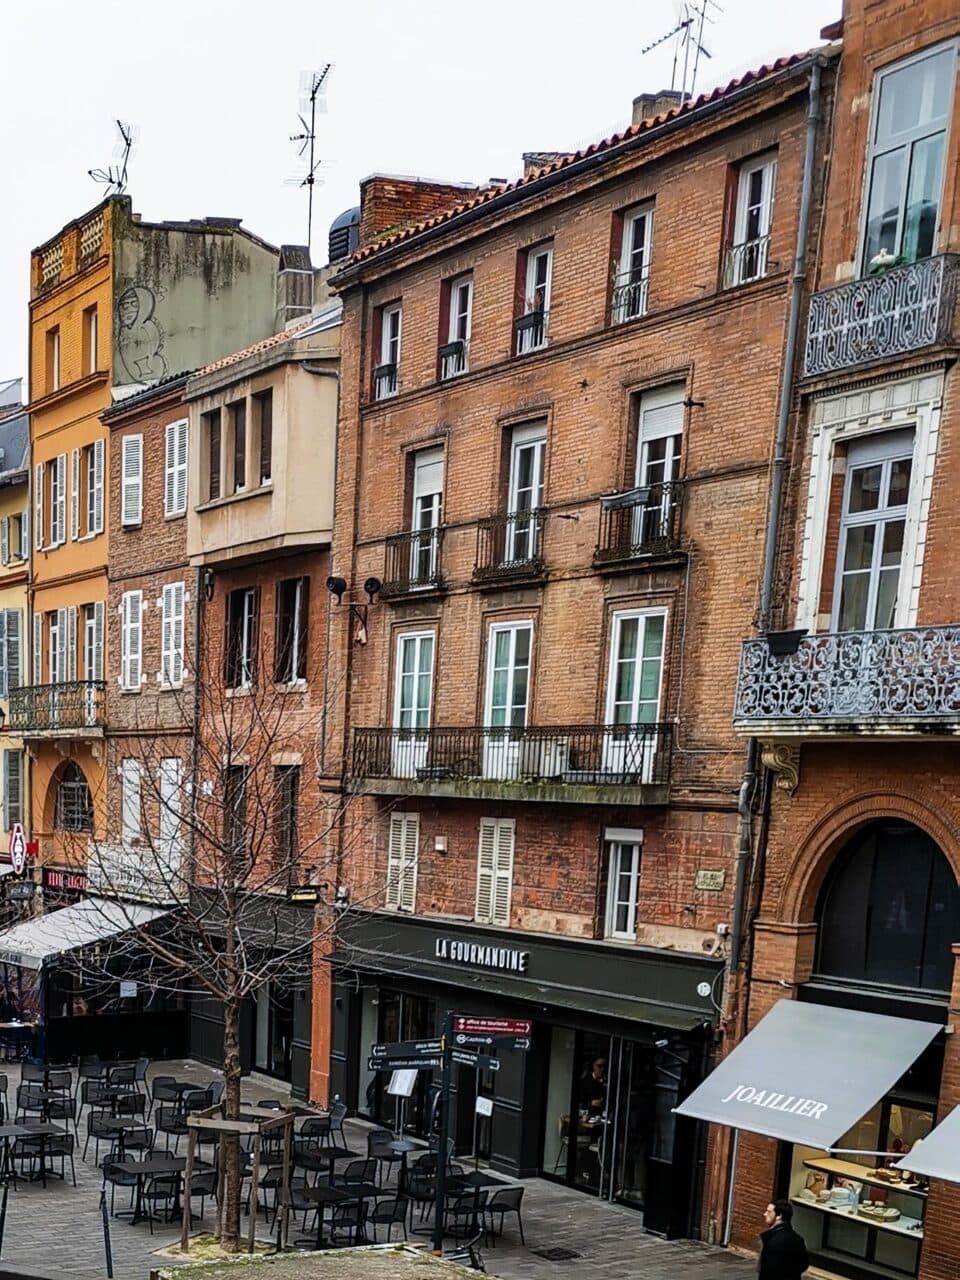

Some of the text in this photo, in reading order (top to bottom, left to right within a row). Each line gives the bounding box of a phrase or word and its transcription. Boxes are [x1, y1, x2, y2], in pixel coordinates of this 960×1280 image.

[436, 938, 526, 971] LA GOURMANDINE
[721, 1085, 828, 1119] JOAILLIER
